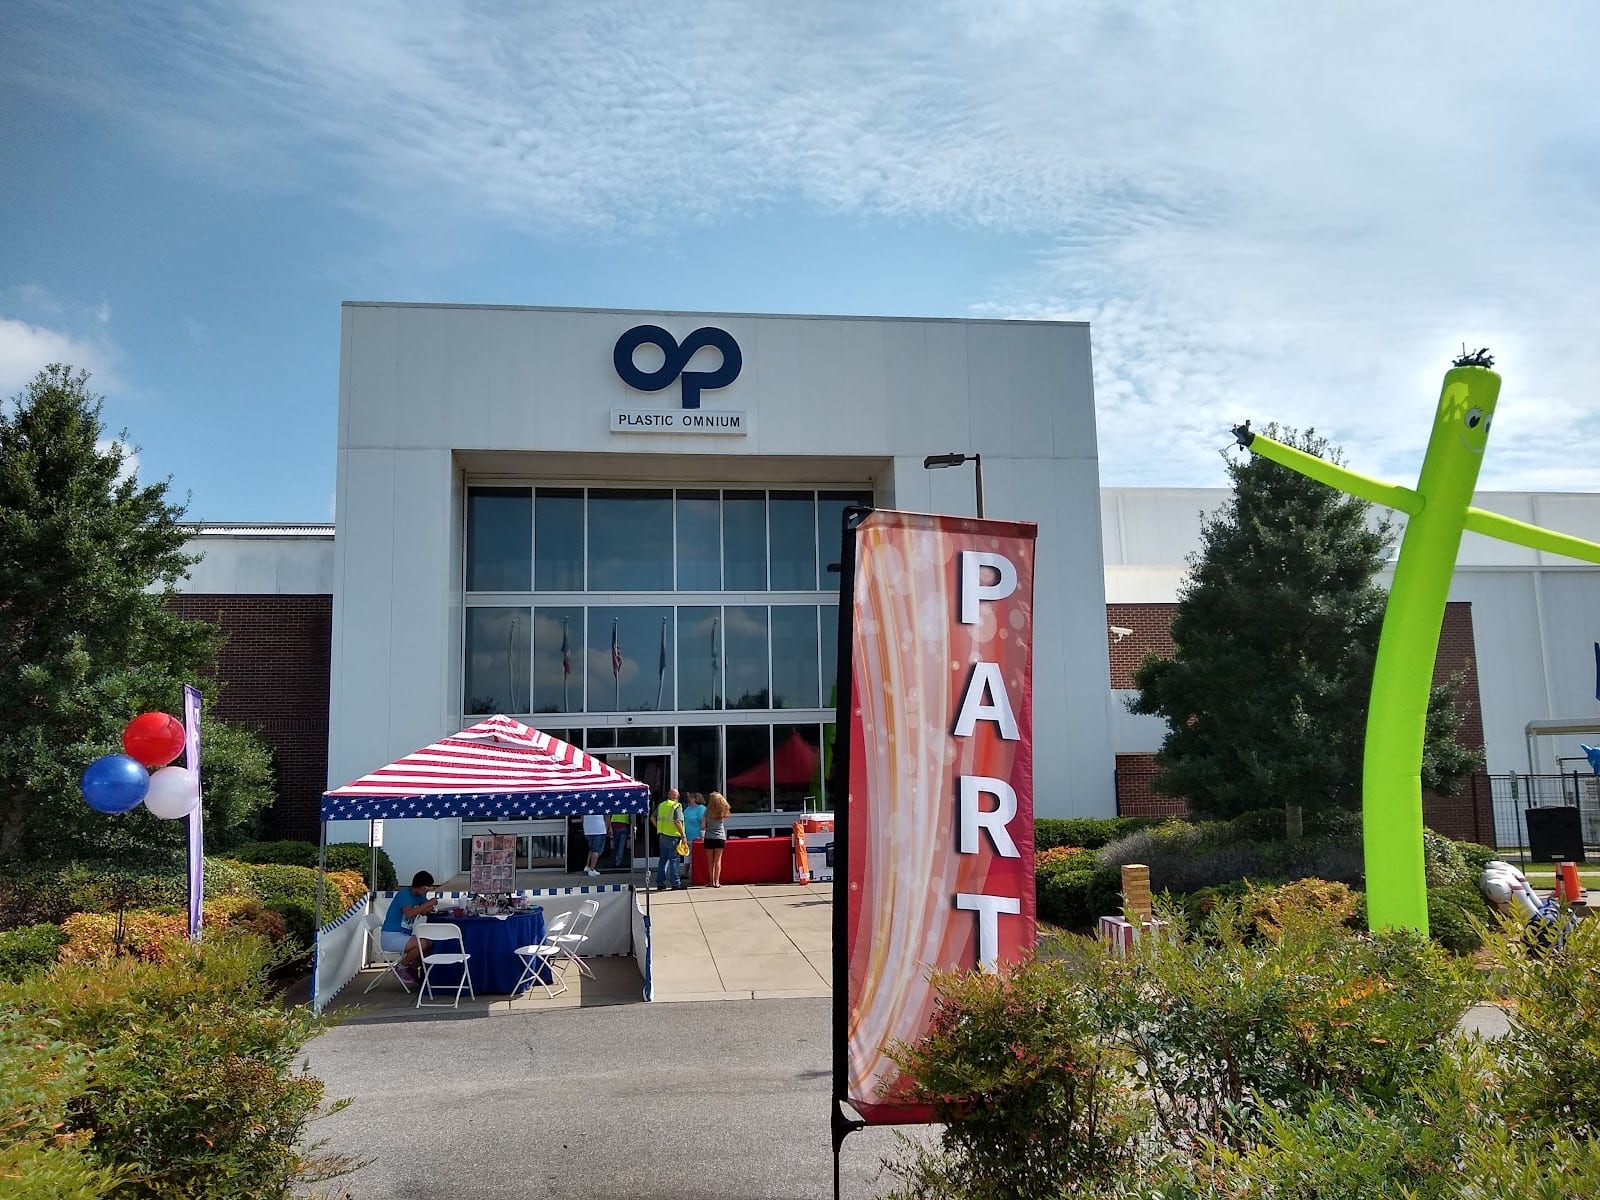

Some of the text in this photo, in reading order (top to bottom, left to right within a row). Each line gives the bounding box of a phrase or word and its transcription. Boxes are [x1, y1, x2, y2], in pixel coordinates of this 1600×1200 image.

[618, 414, 741, 428] PLASTIC OMNIUM
[953, 549, 1021, 976] PART
